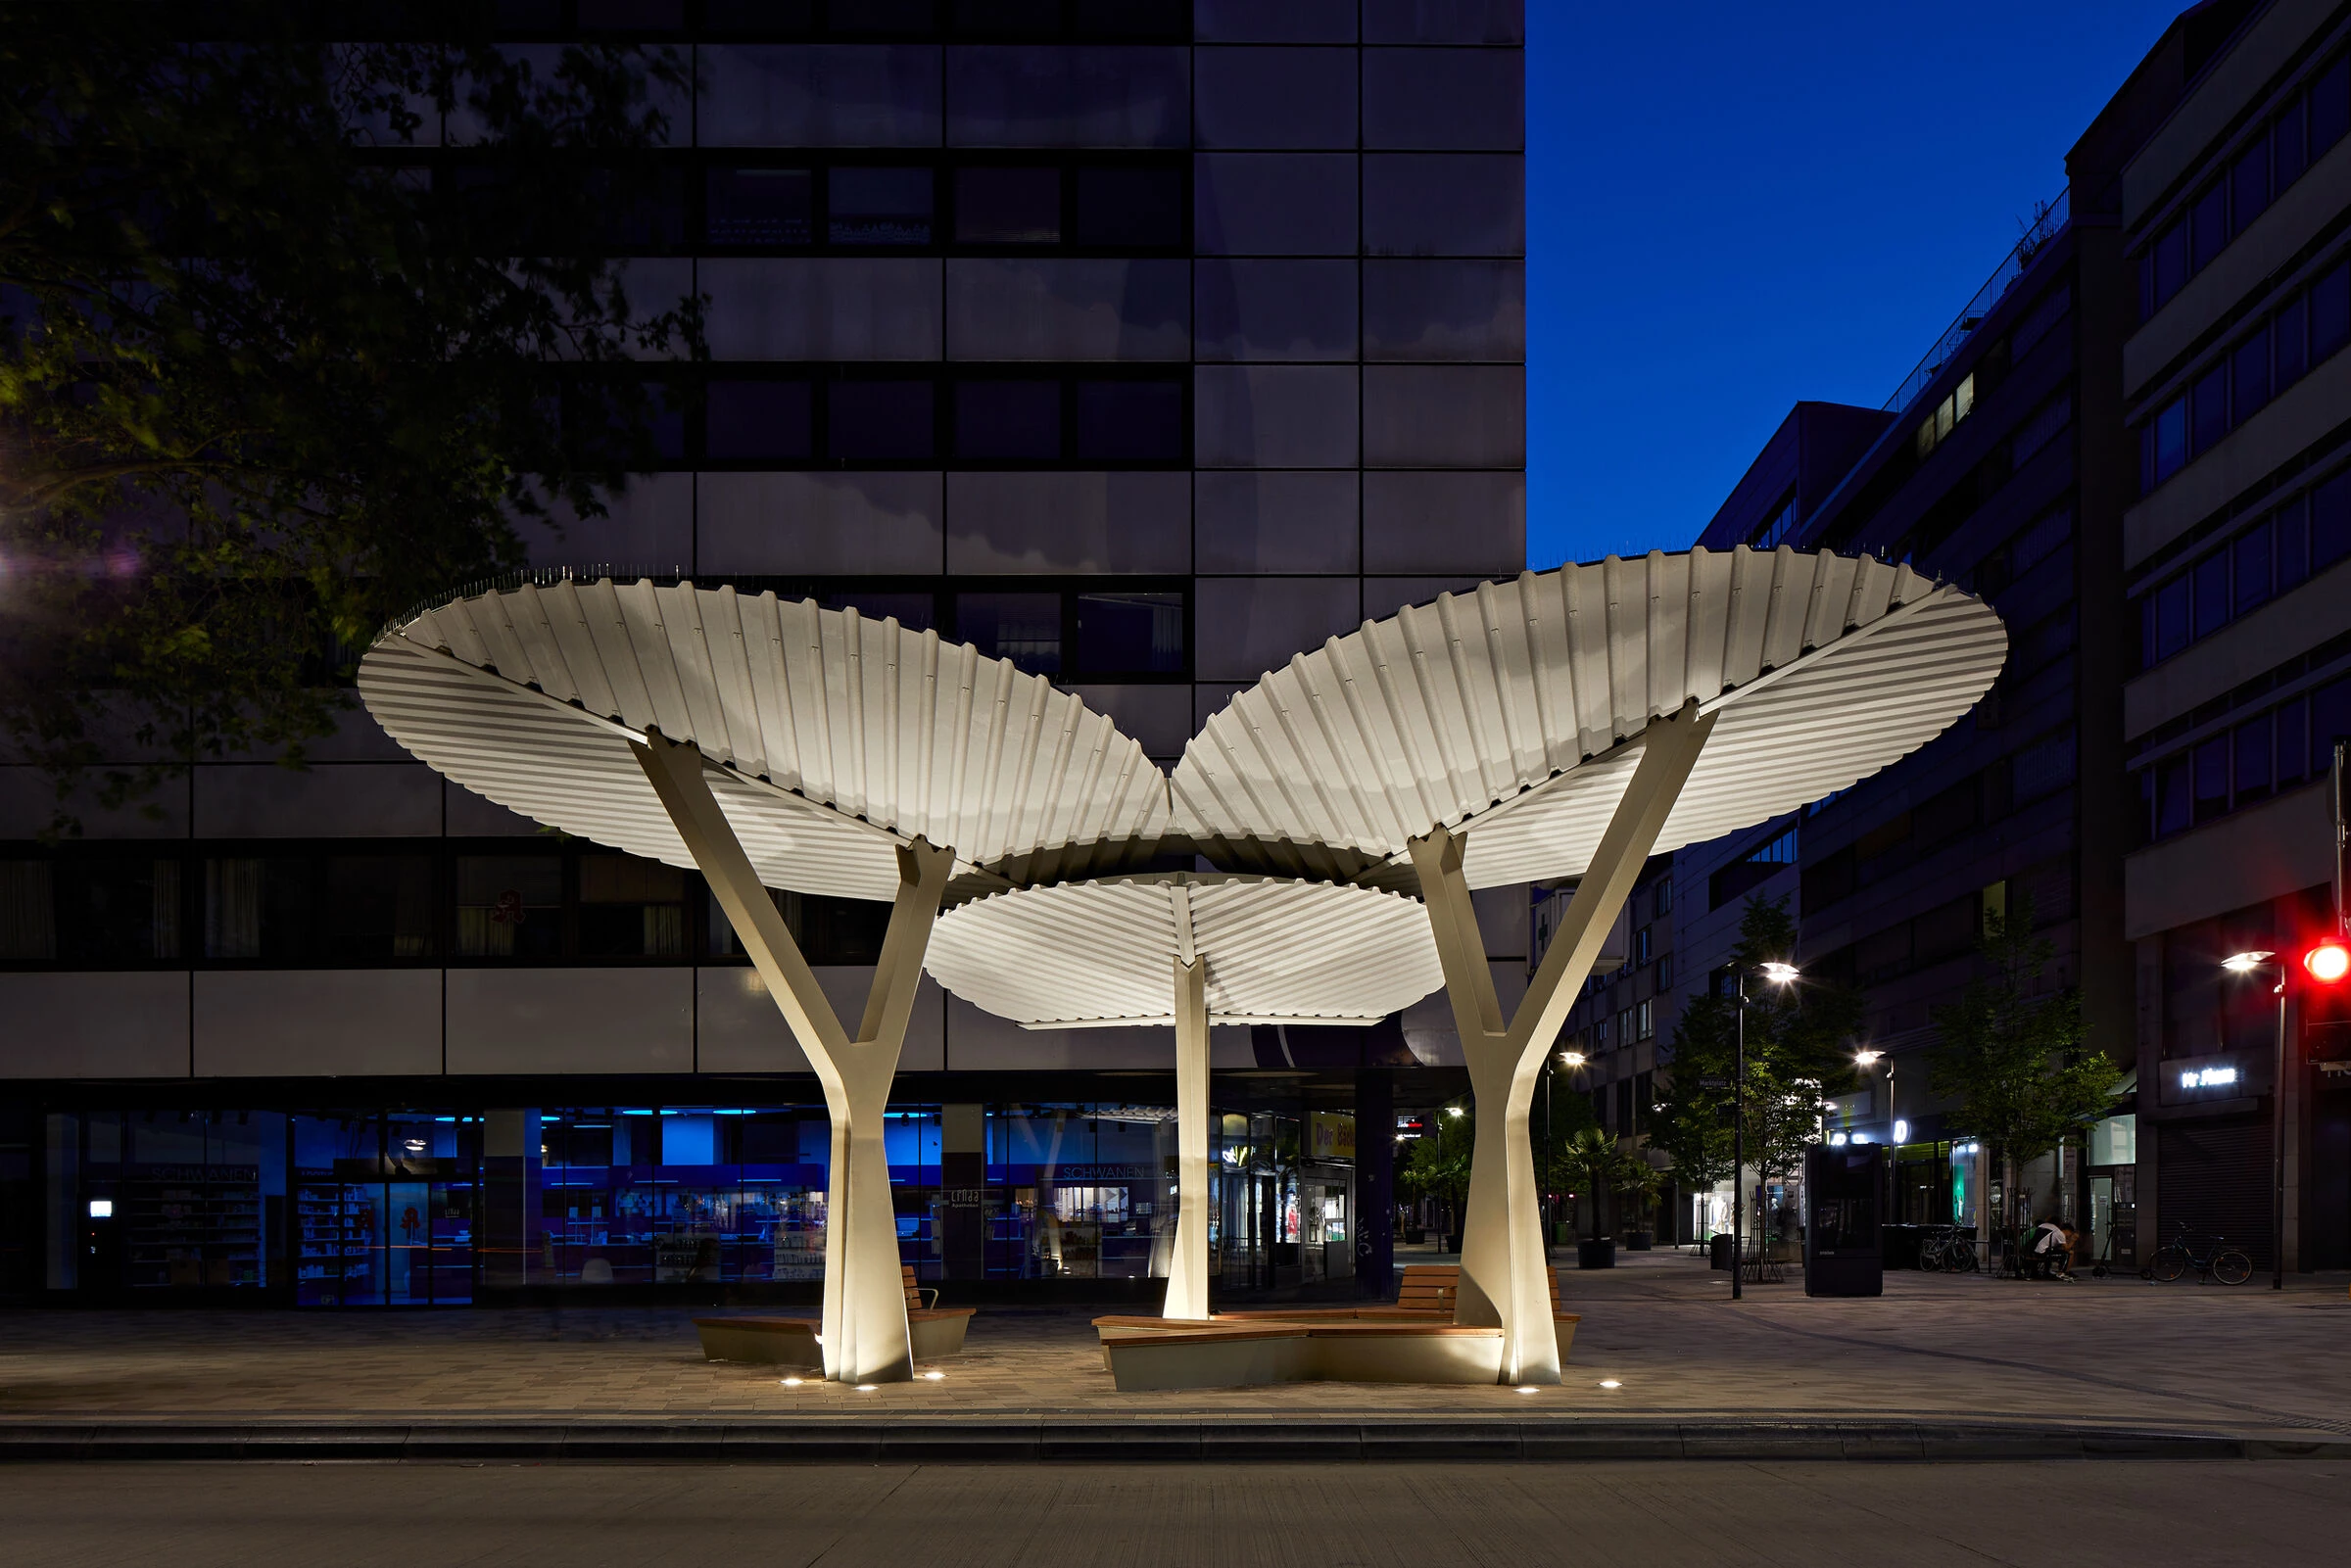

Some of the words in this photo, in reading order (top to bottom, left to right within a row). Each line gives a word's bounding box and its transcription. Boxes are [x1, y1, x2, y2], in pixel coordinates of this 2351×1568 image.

[1317, 1122, 1333, 1146] Der
[151, 1166, 257, 1181] SCHWANEN
[1063, 1166, 1144, 1178] SCHWANEN
